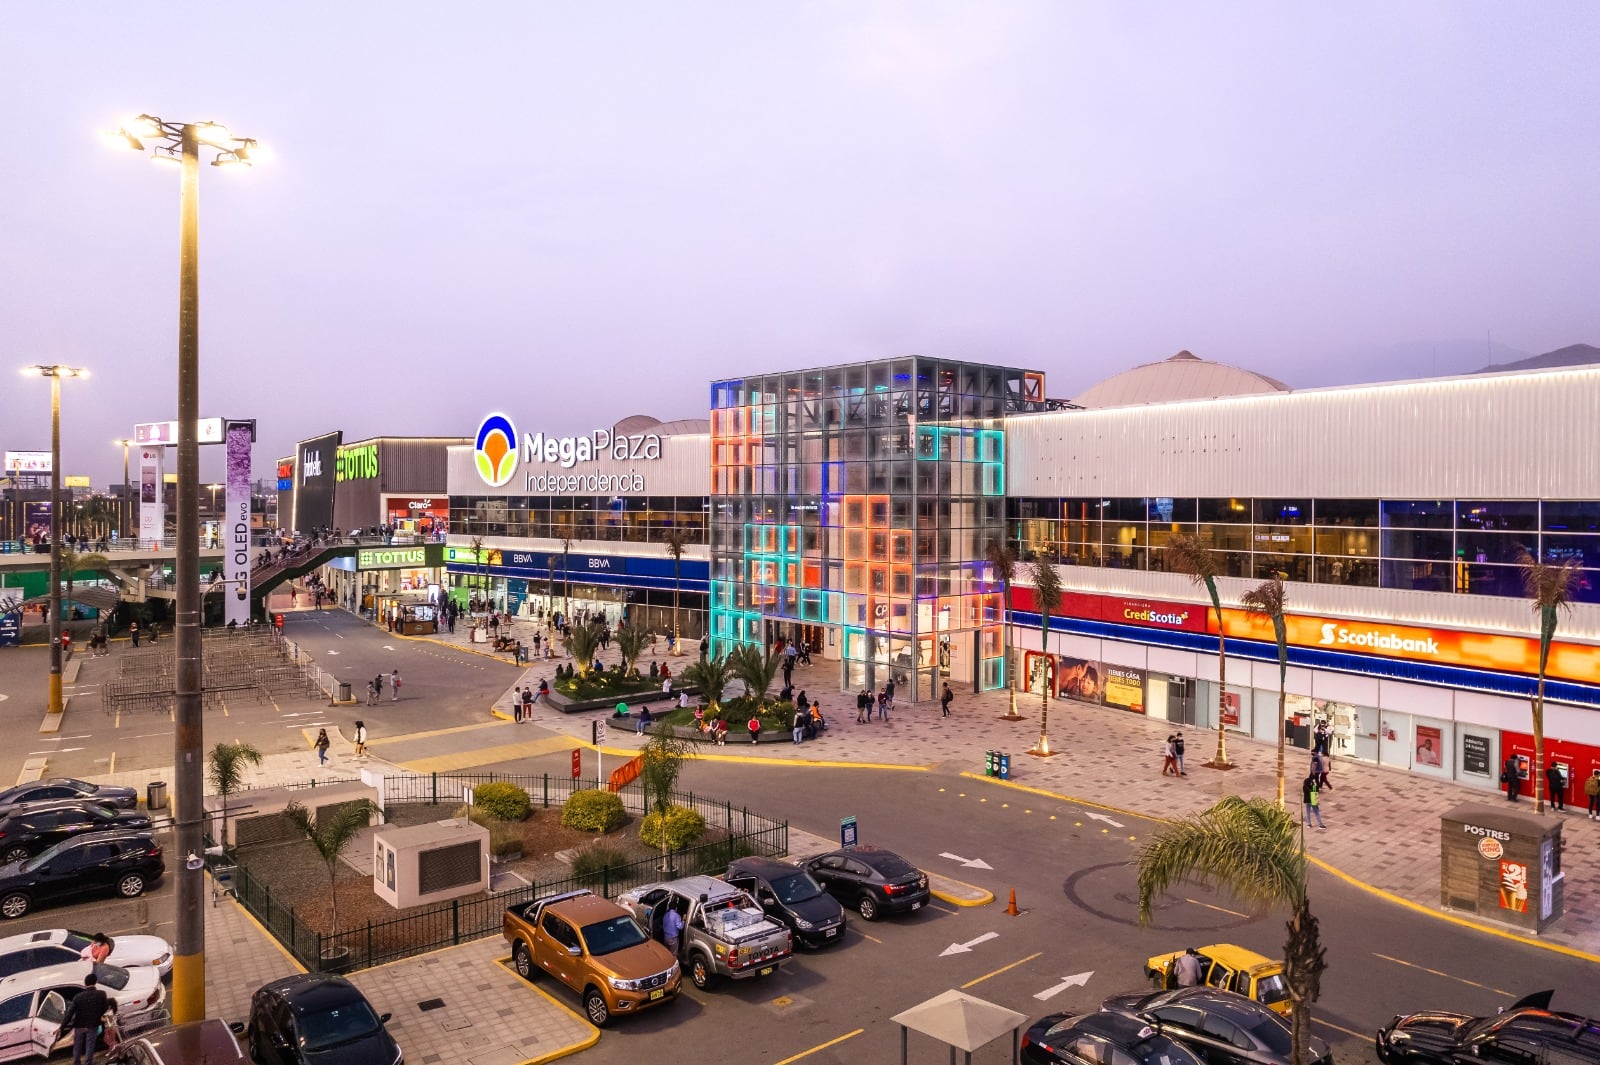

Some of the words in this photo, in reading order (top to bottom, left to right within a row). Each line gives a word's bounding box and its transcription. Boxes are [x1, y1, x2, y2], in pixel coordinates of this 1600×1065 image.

[524, 427, 661, 468] MegaPlaza
[344, 444, 378, 480] TOTTUS
[525, 469, 644, 495] Independencia
[240, 503, 248, 520] evo
[408, 500, 428, 509] Claro
[235, 523, 248, 565] OLED
[374, 551, 425, 564] TOTTUS
[513, 554, 533, 563] BBVA
[588, 559, 610, 568] BBVA
[1124, 609, 1182, 625] CrediScotia
[1338, 628, 1439, 654] Scotiabank
[1126, 678, 1141, 687] TODO
[1464, 825, 1510, 841] POSTRES
[748, 946, 780, 961] TOYOTA
